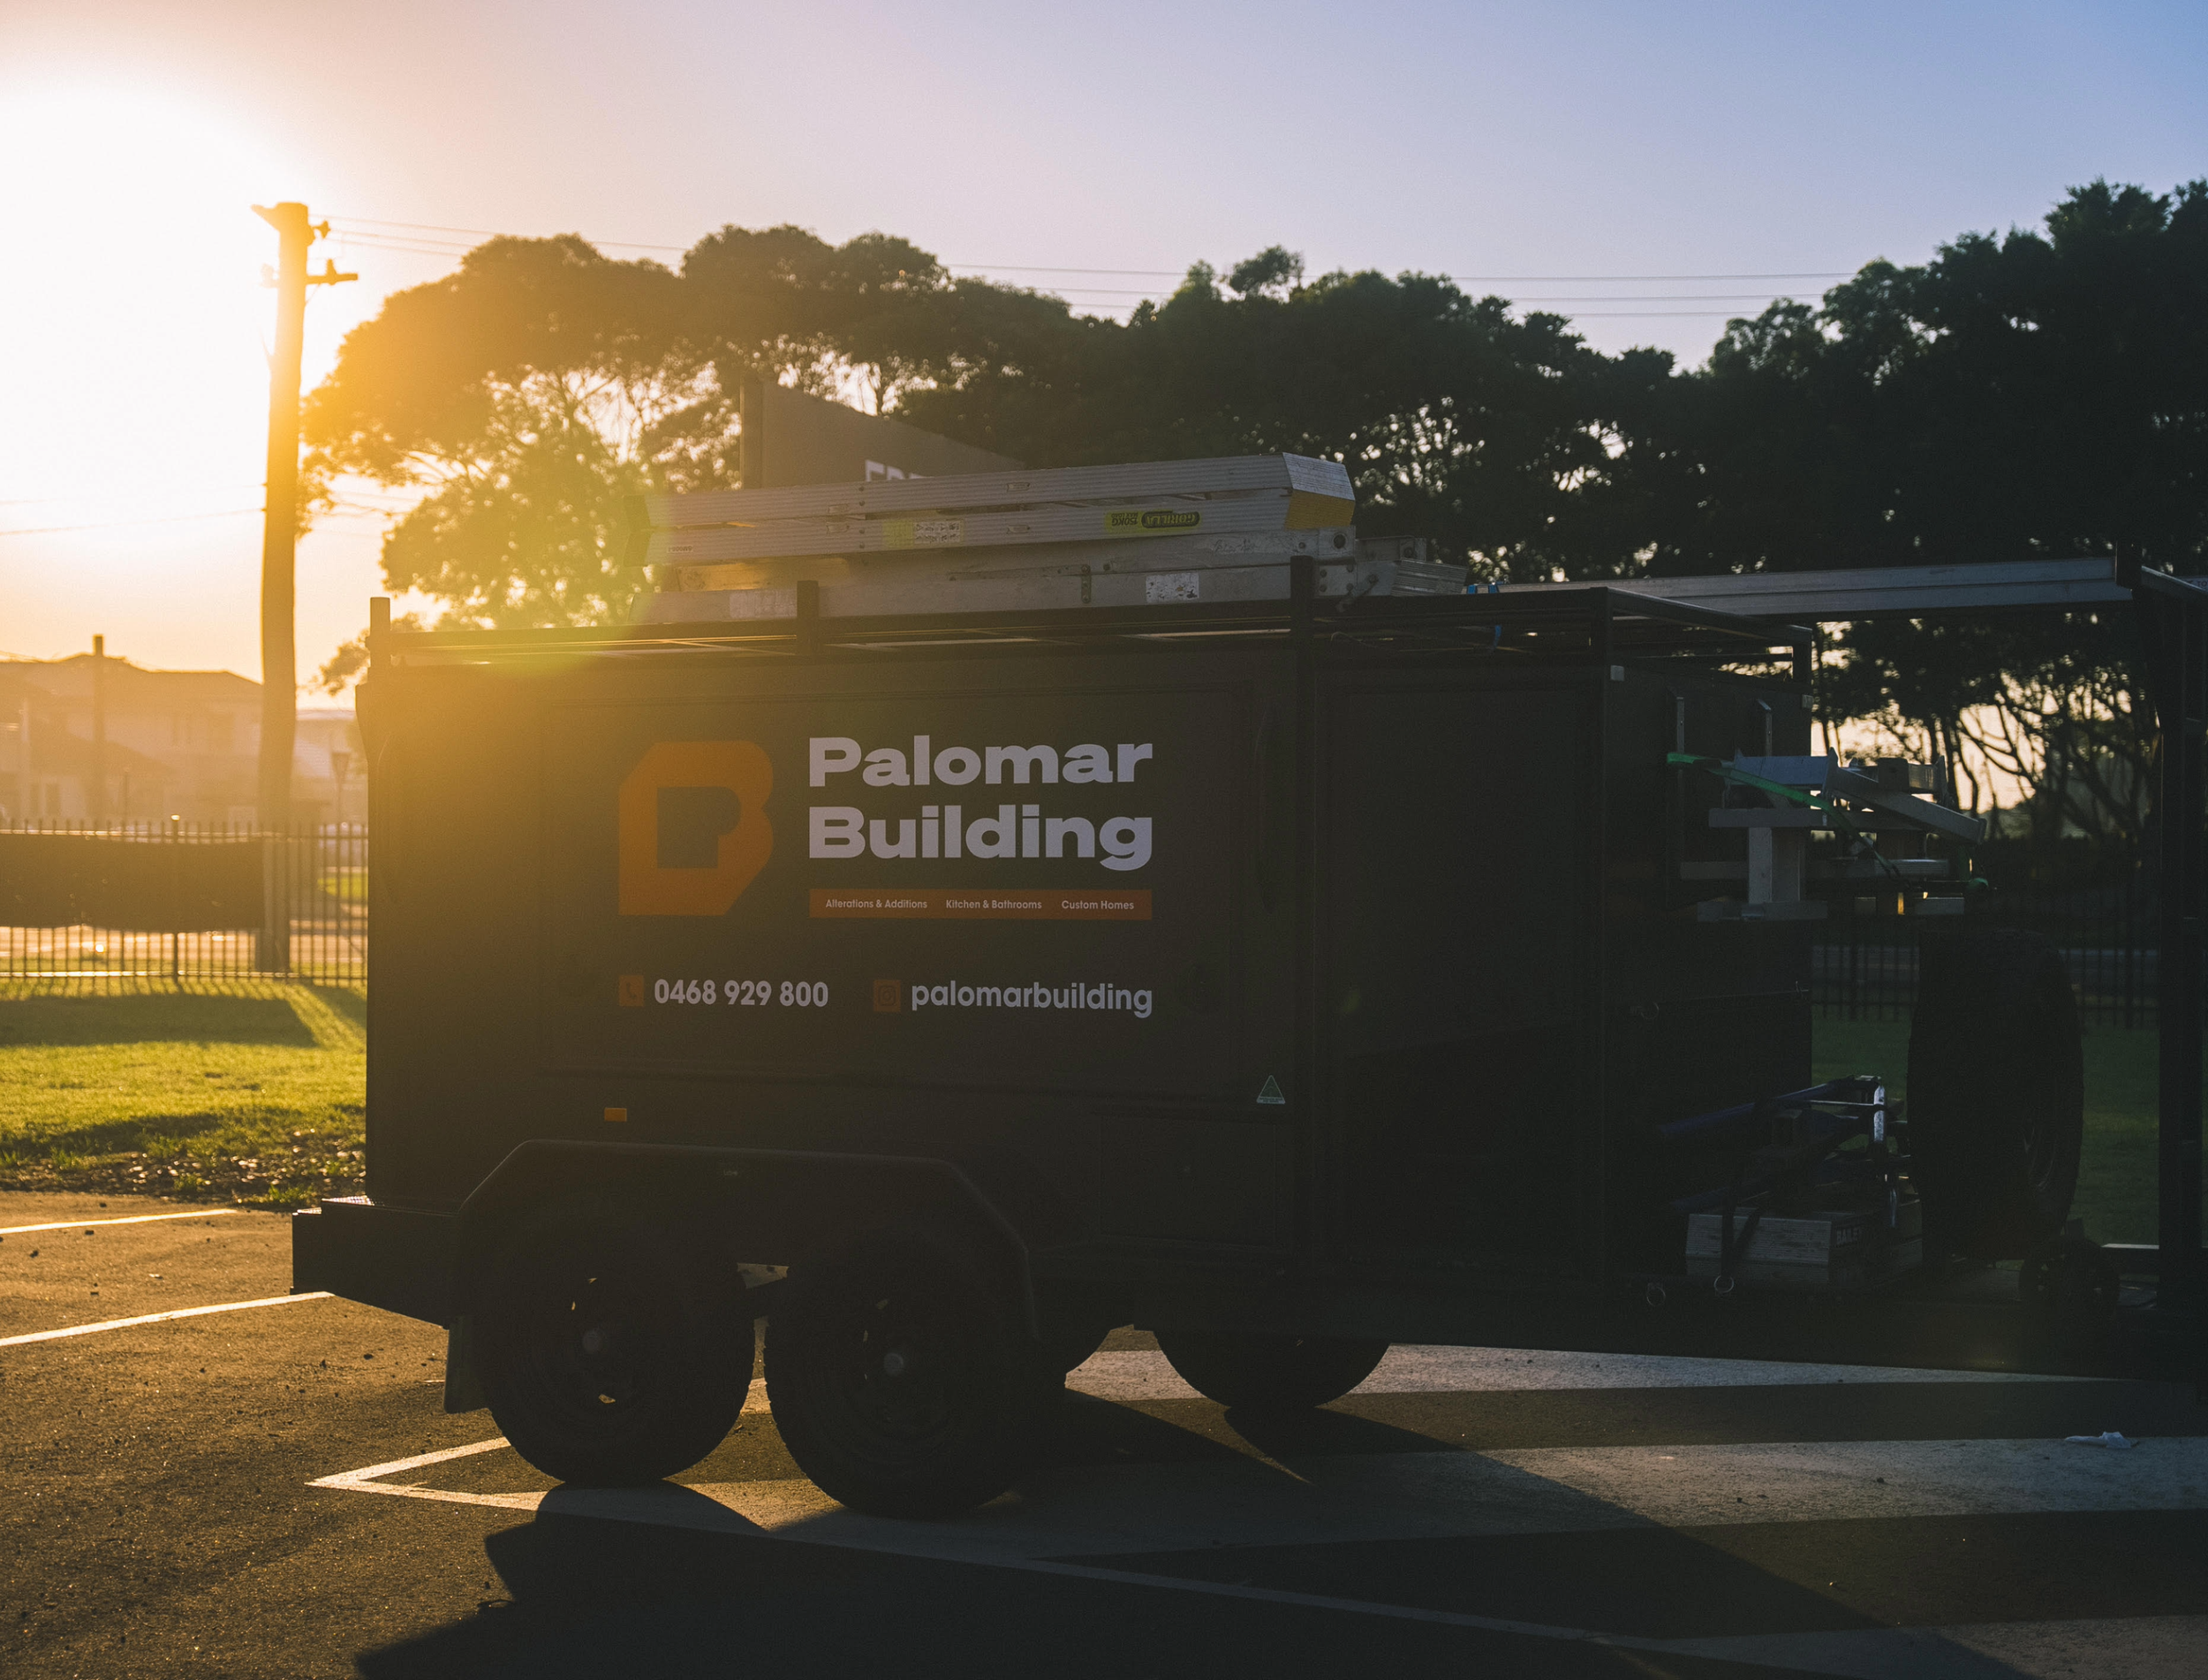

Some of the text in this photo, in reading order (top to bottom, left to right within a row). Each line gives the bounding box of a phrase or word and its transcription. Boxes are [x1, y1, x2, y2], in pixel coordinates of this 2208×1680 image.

[1111, 518, 1138, 526] 150KG
[1146, 512, 1198, 526] GORILLA
[809, 734, 1153, 787] Palomar
[809, 804, 1153, 873] Building
[825, 899, 928, 909] Alterations & Additions
[945, 899, 1042, 910] Kitchen & Bathrooms
[1061, 900, 1135, 910] Custom Homes
[654, 979, 828, 1008] 0468 929 800
[911, 980, 1153, 1019] palomarbuilding
